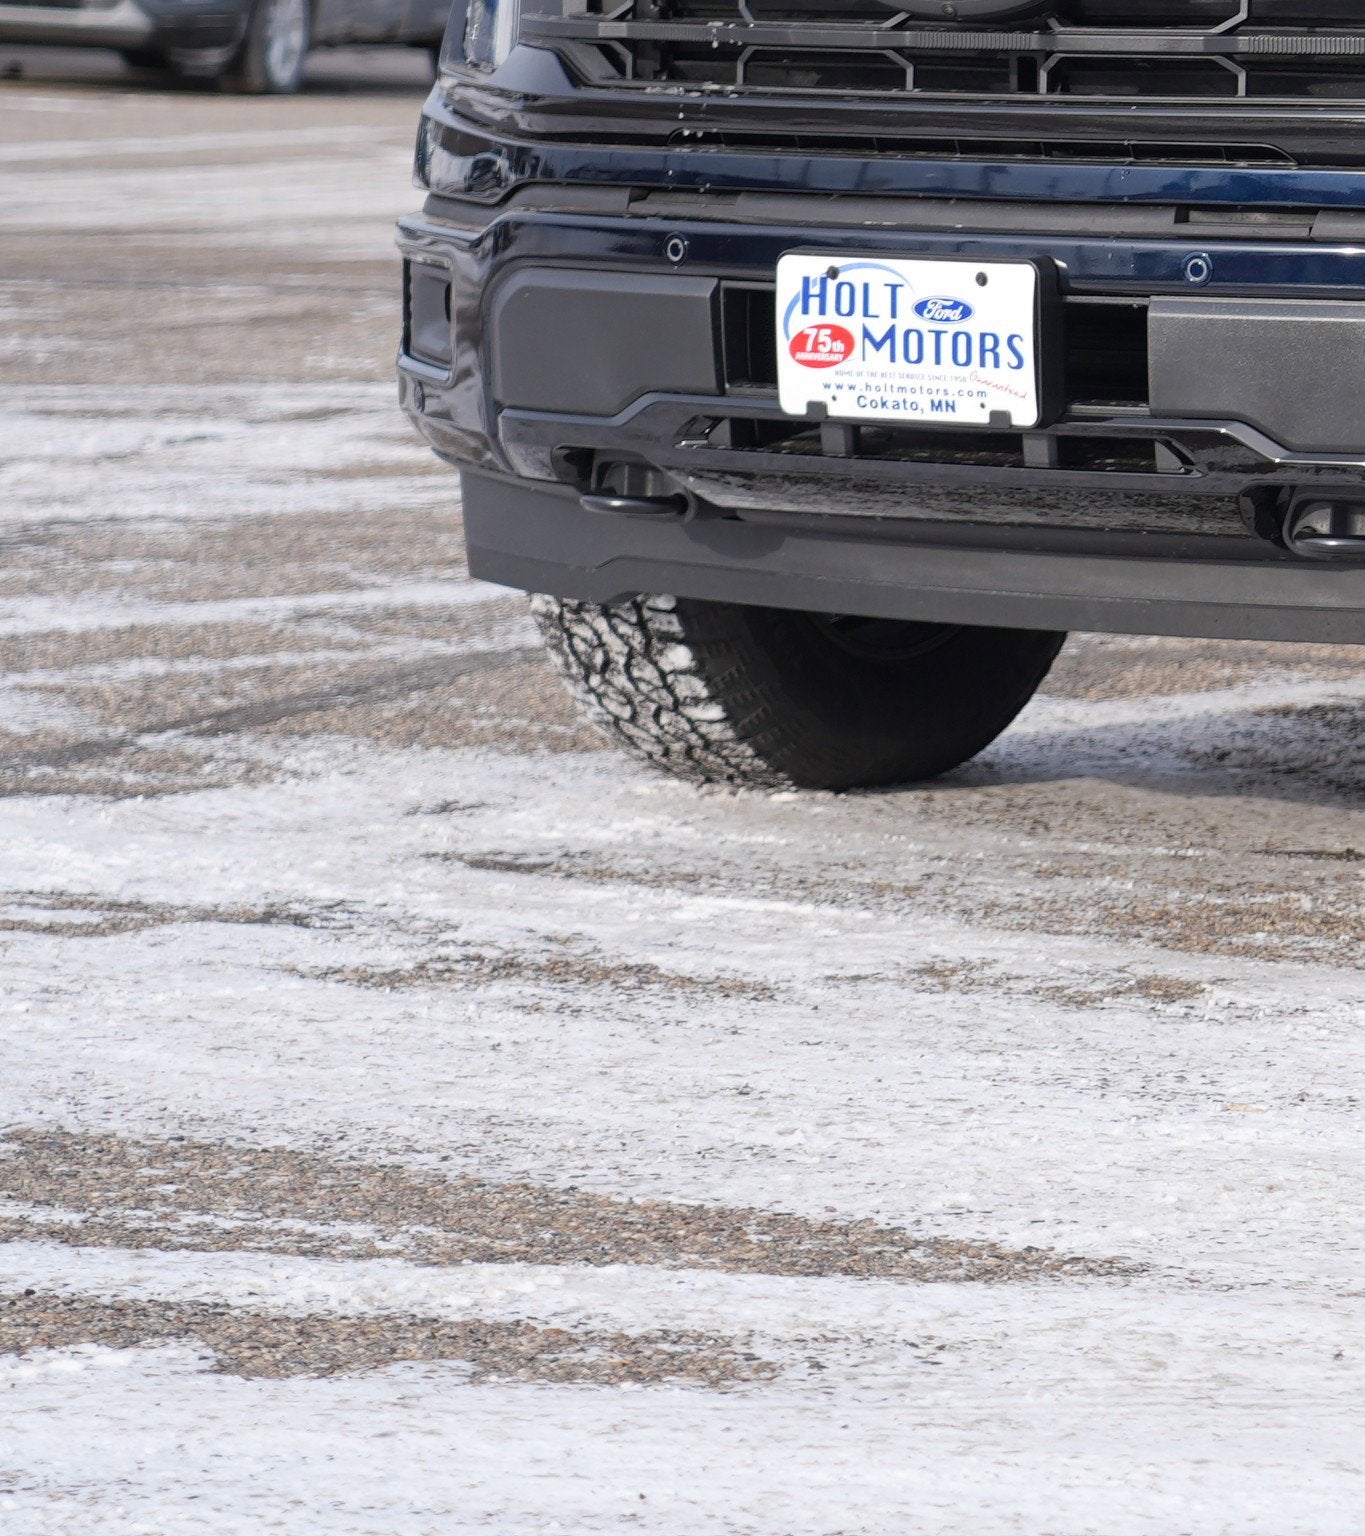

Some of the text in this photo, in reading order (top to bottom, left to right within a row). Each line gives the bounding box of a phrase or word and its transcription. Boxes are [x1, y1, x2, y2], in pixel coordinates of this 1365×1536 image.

[801, 276, 903, 320] HOLT
[922, 298, 963, 322] Ford
[802, 327, 845, 353] 75th
[862, 323, 1025, 371] MOTORS
[822, 380, 988, 398] www.holtmotors.com
[857, 395, 956, 414] Cokato, MN
